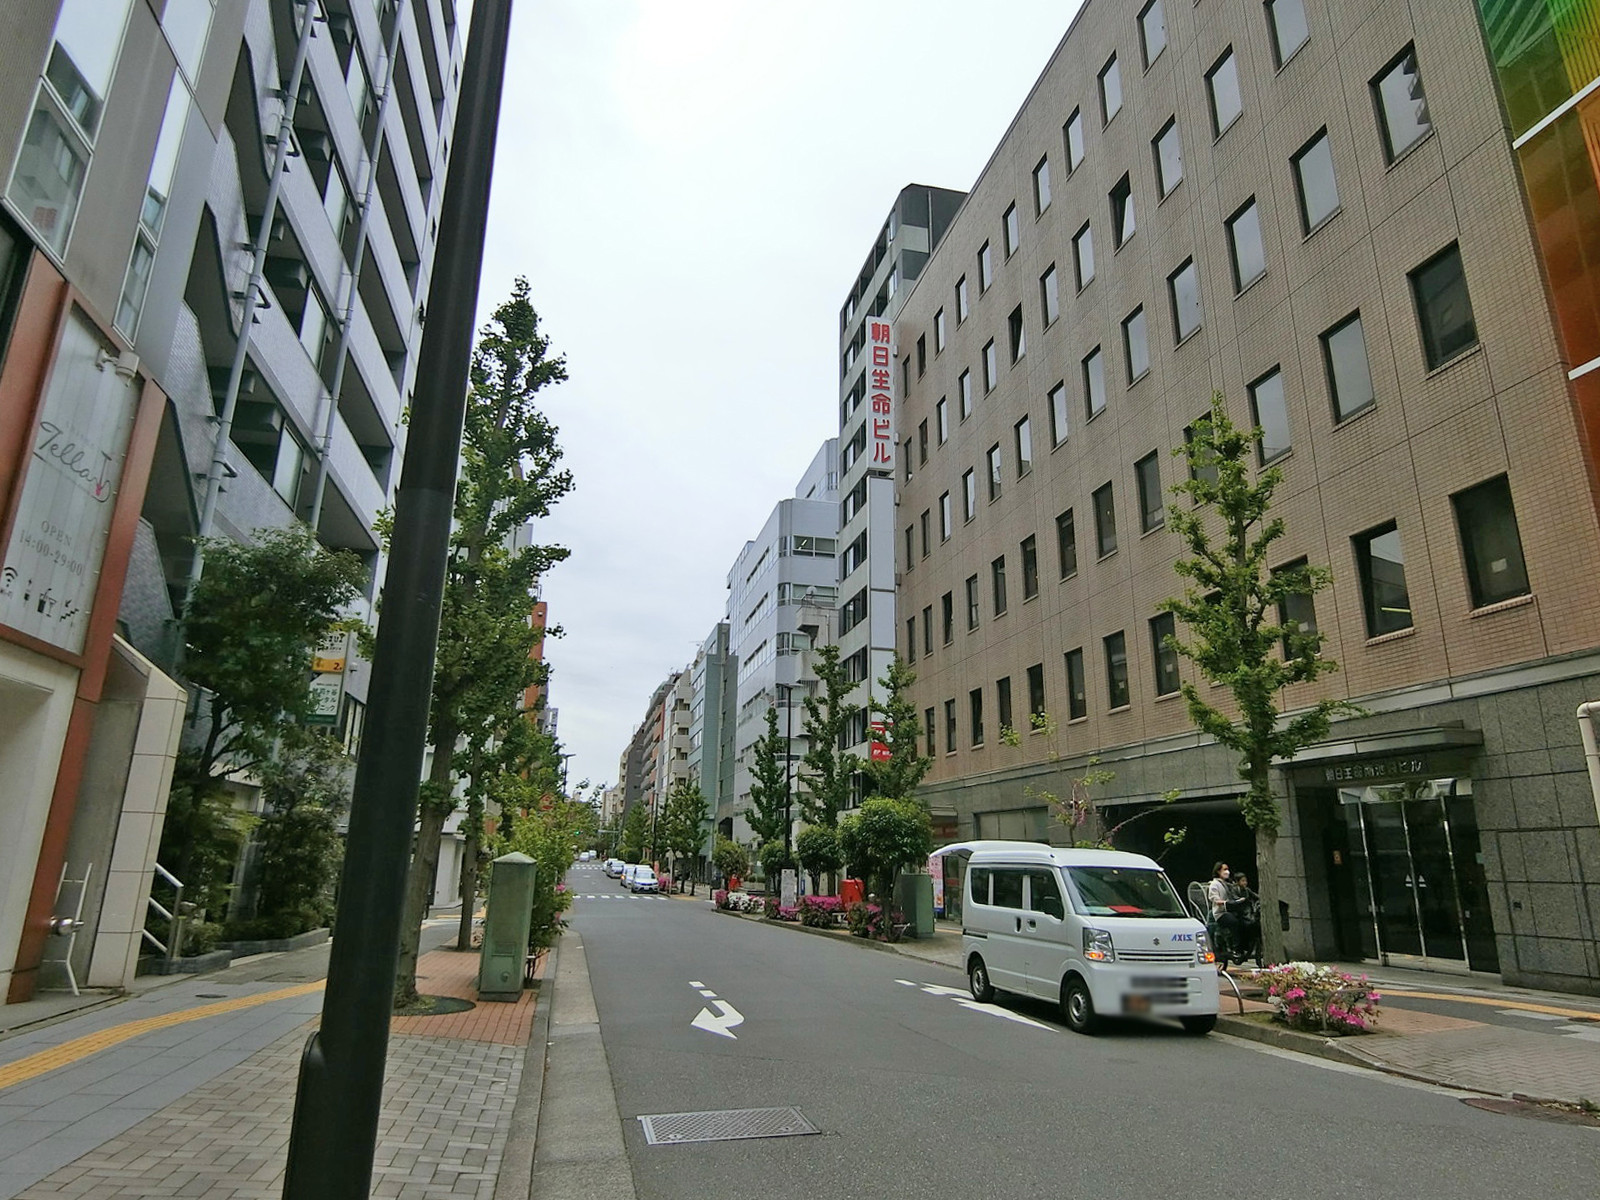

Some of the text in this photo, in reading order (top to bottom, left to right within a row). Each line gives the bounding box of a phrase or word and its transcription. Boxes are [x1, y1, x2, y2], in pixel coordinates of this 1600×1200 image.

[871, 322, 891, 463] 朝日生命ビル
[41, 520, 72, 547] OPEN
[1171, 934, 1193, 942] AXIS
